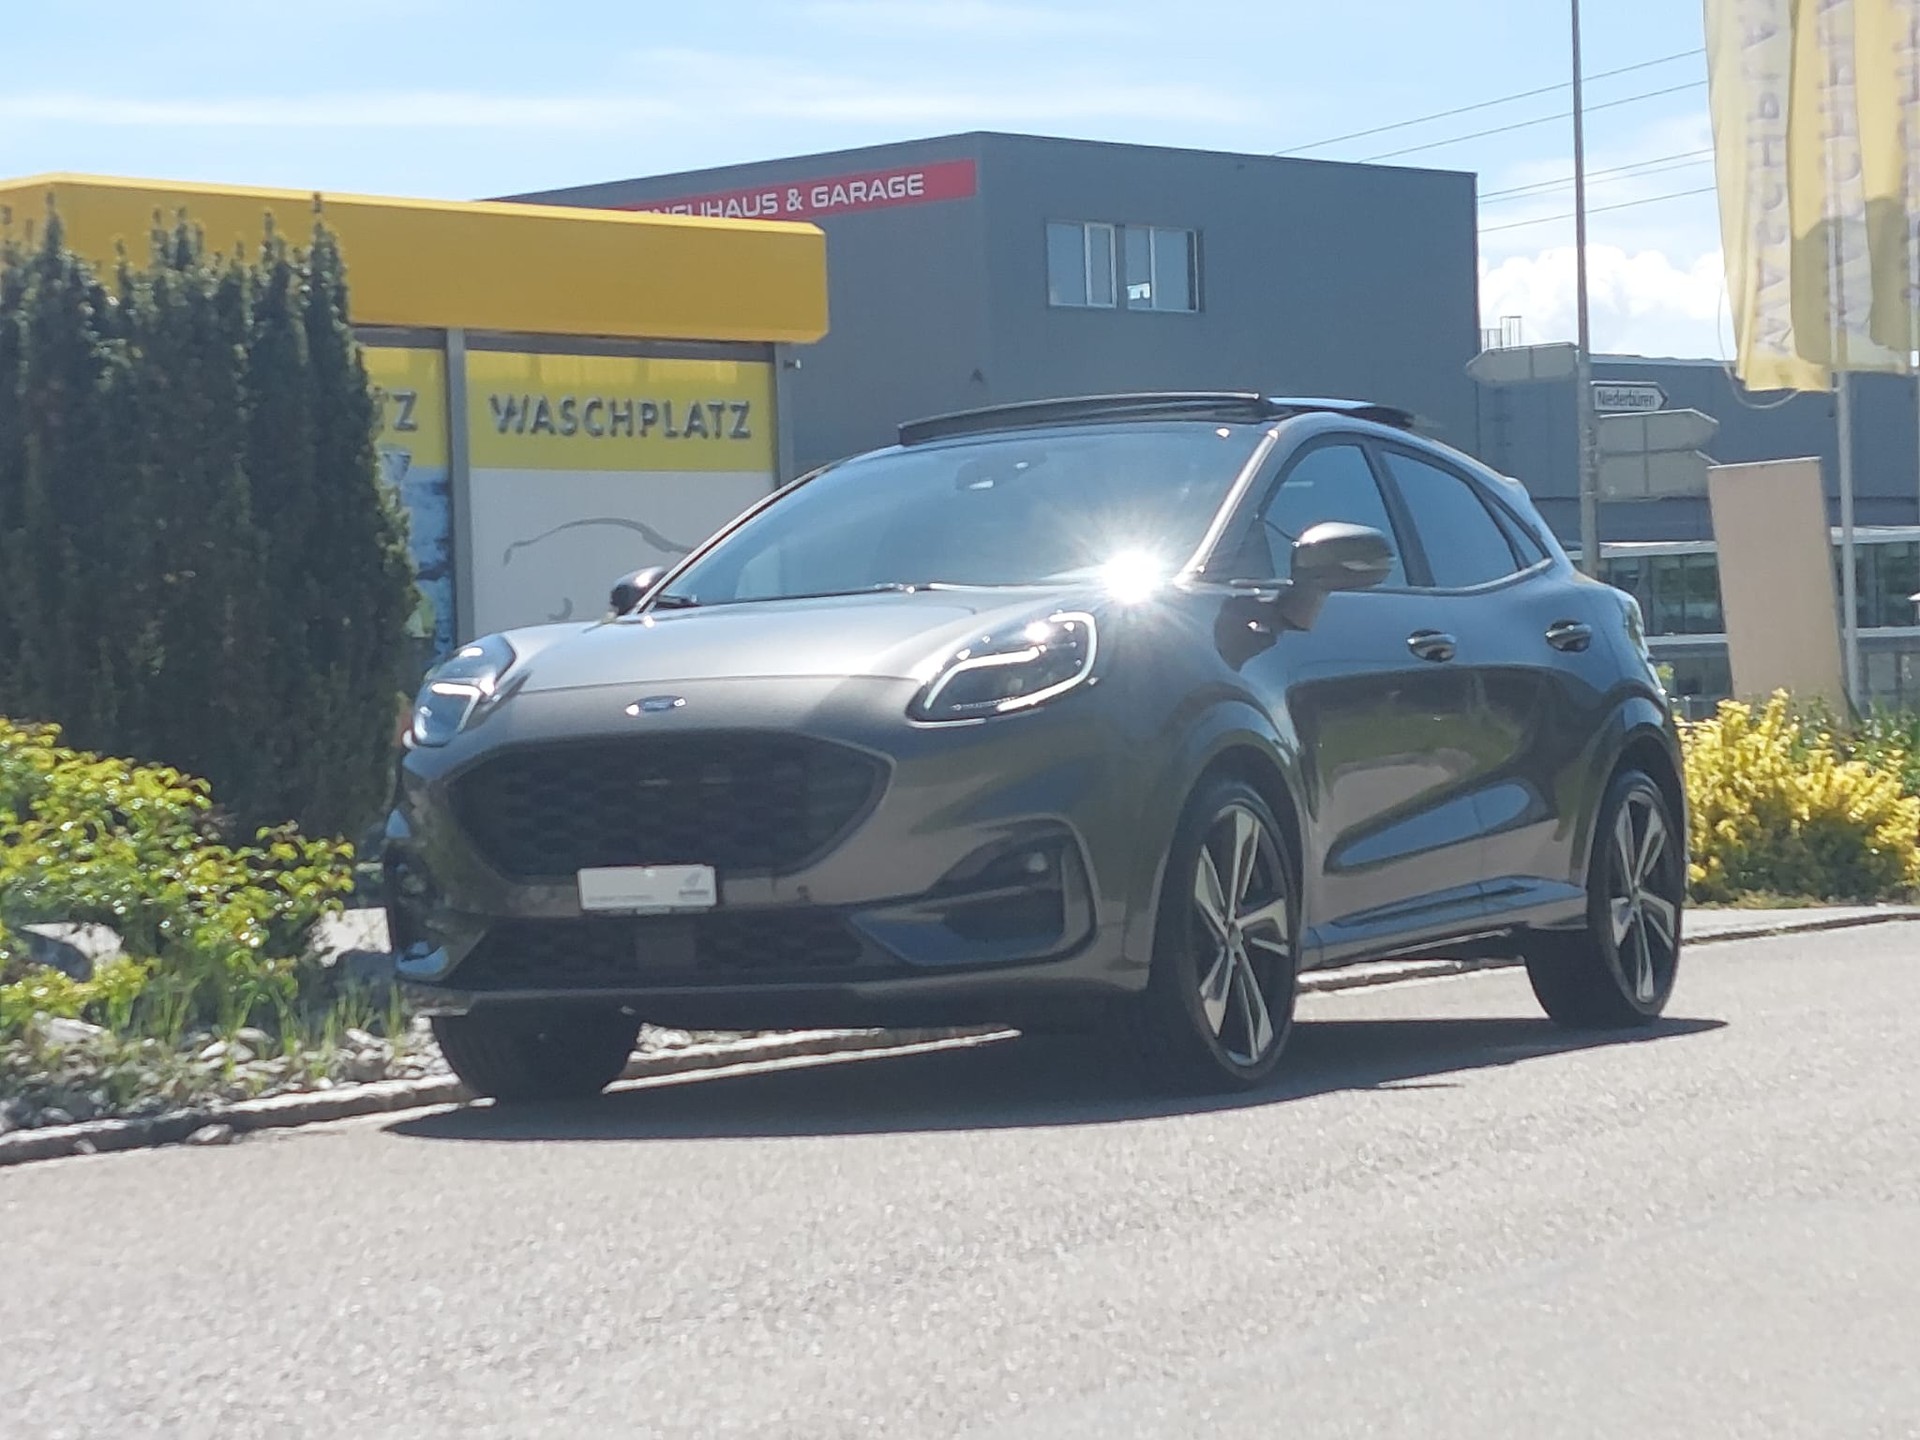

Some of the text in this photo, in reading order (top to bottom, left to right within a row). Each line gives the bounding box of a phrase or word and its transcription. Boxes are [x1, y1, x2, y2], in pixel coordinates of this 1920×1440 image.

[638, 173, 924, 217] UHAUS & GARAGE
[489, 394, 752, 439] WASCHPLATZ
